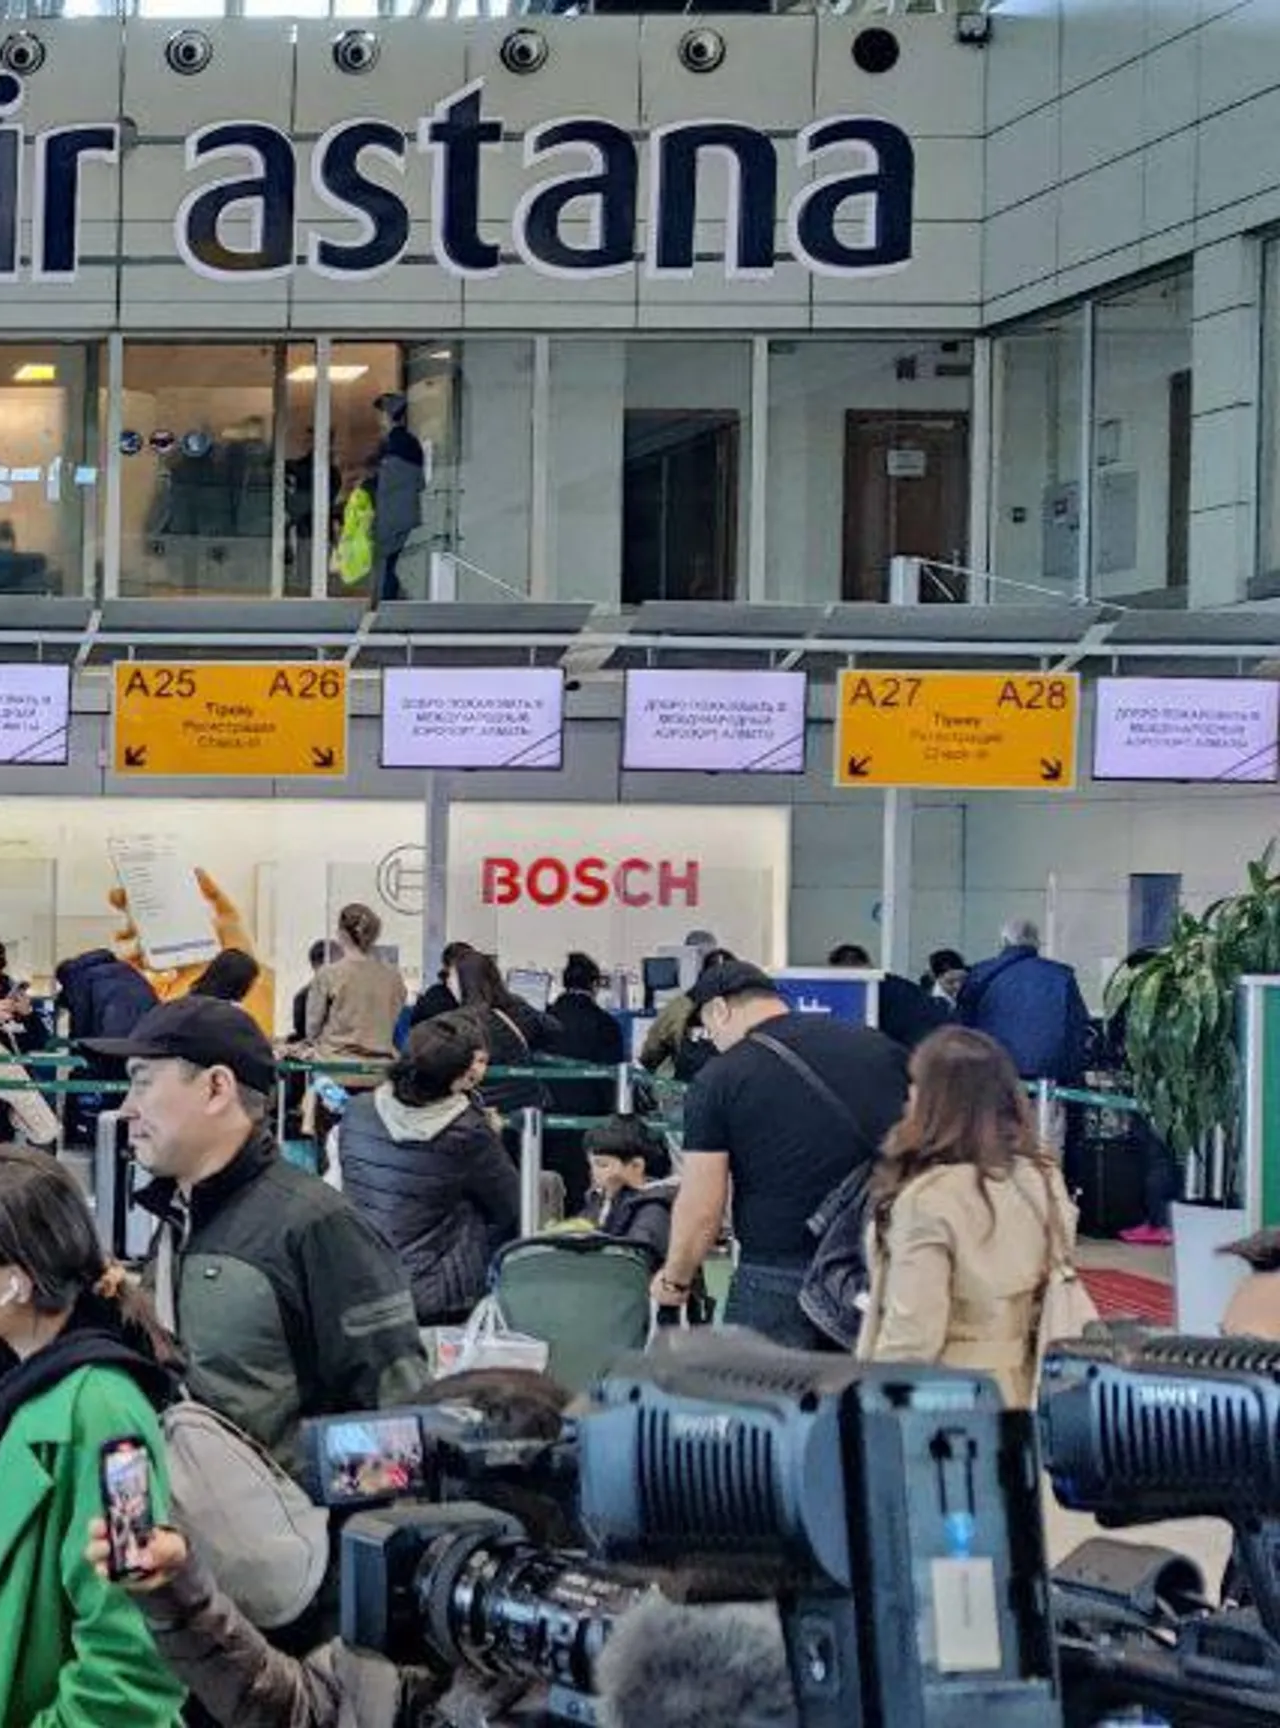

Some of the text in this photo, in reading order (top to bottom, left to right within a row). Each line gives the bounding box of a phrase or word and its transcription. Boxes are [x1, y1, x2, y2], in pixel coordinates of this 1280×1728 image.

[175, 80, 916, 280] astana
[125, 671, 340, 698] A25 A26
[850, 679, 1067, 709] A27 A28
[482, 857, 701, 907] BOSCH
